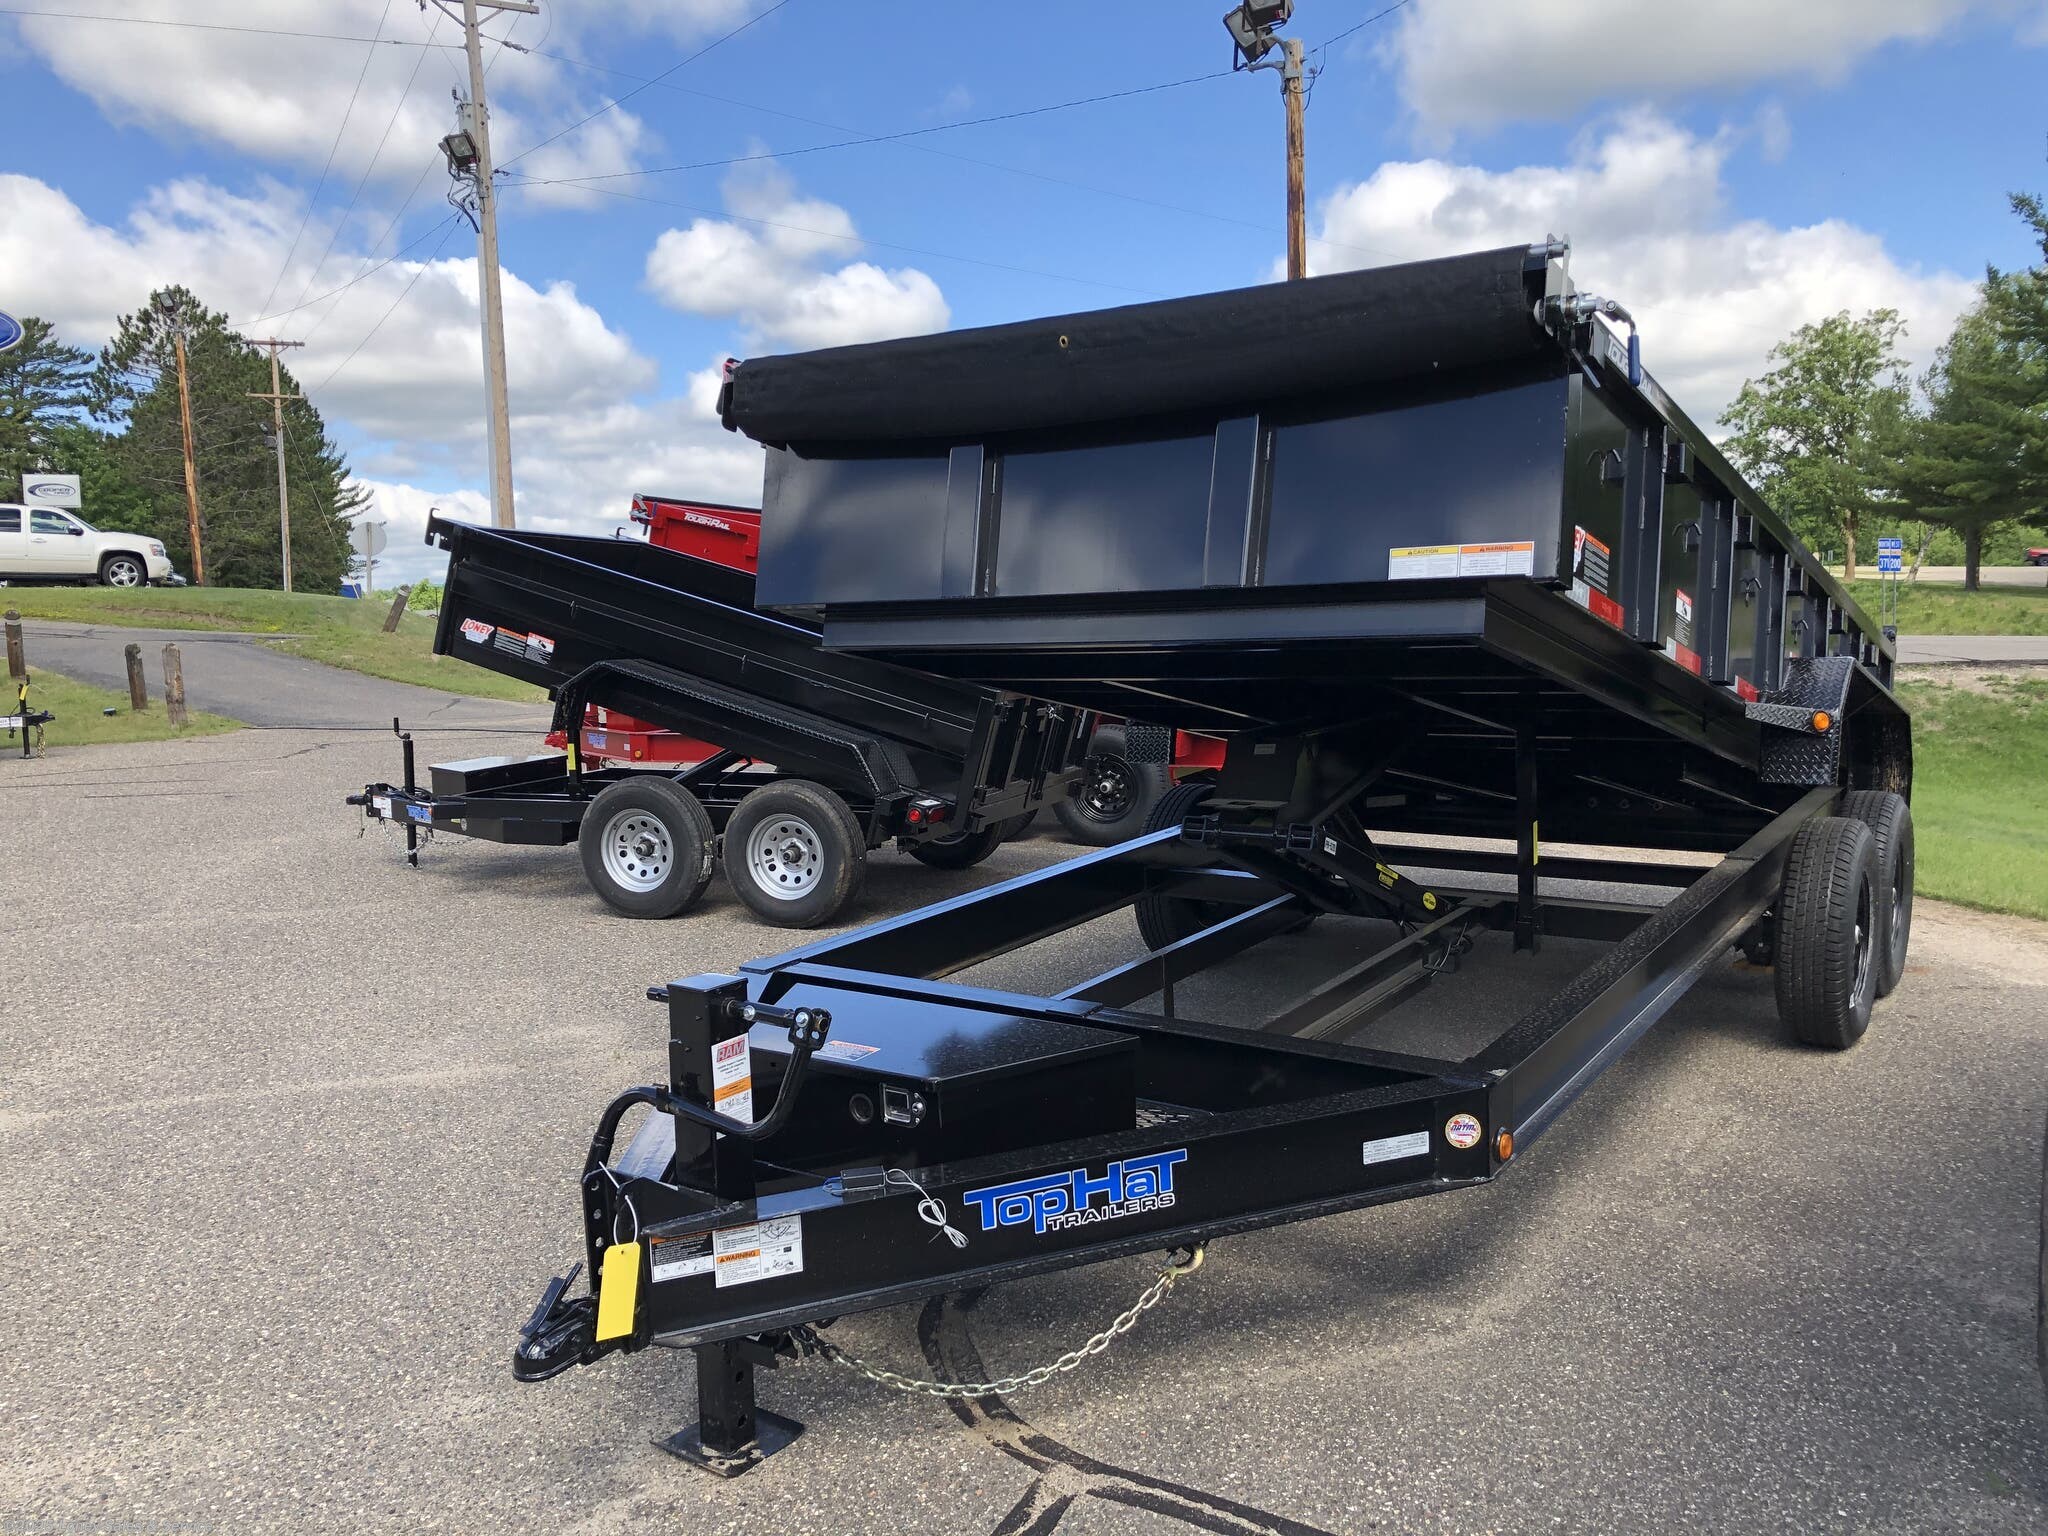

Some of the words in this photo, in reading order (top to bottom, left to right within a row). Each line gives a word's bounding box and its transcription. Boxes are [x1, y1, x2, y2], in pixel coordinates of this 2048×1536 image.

[462, 619, 493, 635] LONEY
[716, 1039, 745, 1063] RAM
[1047, 1192, 1176, 1231] TRAILERS
[725, 1250, 756, 1262] WARNING
